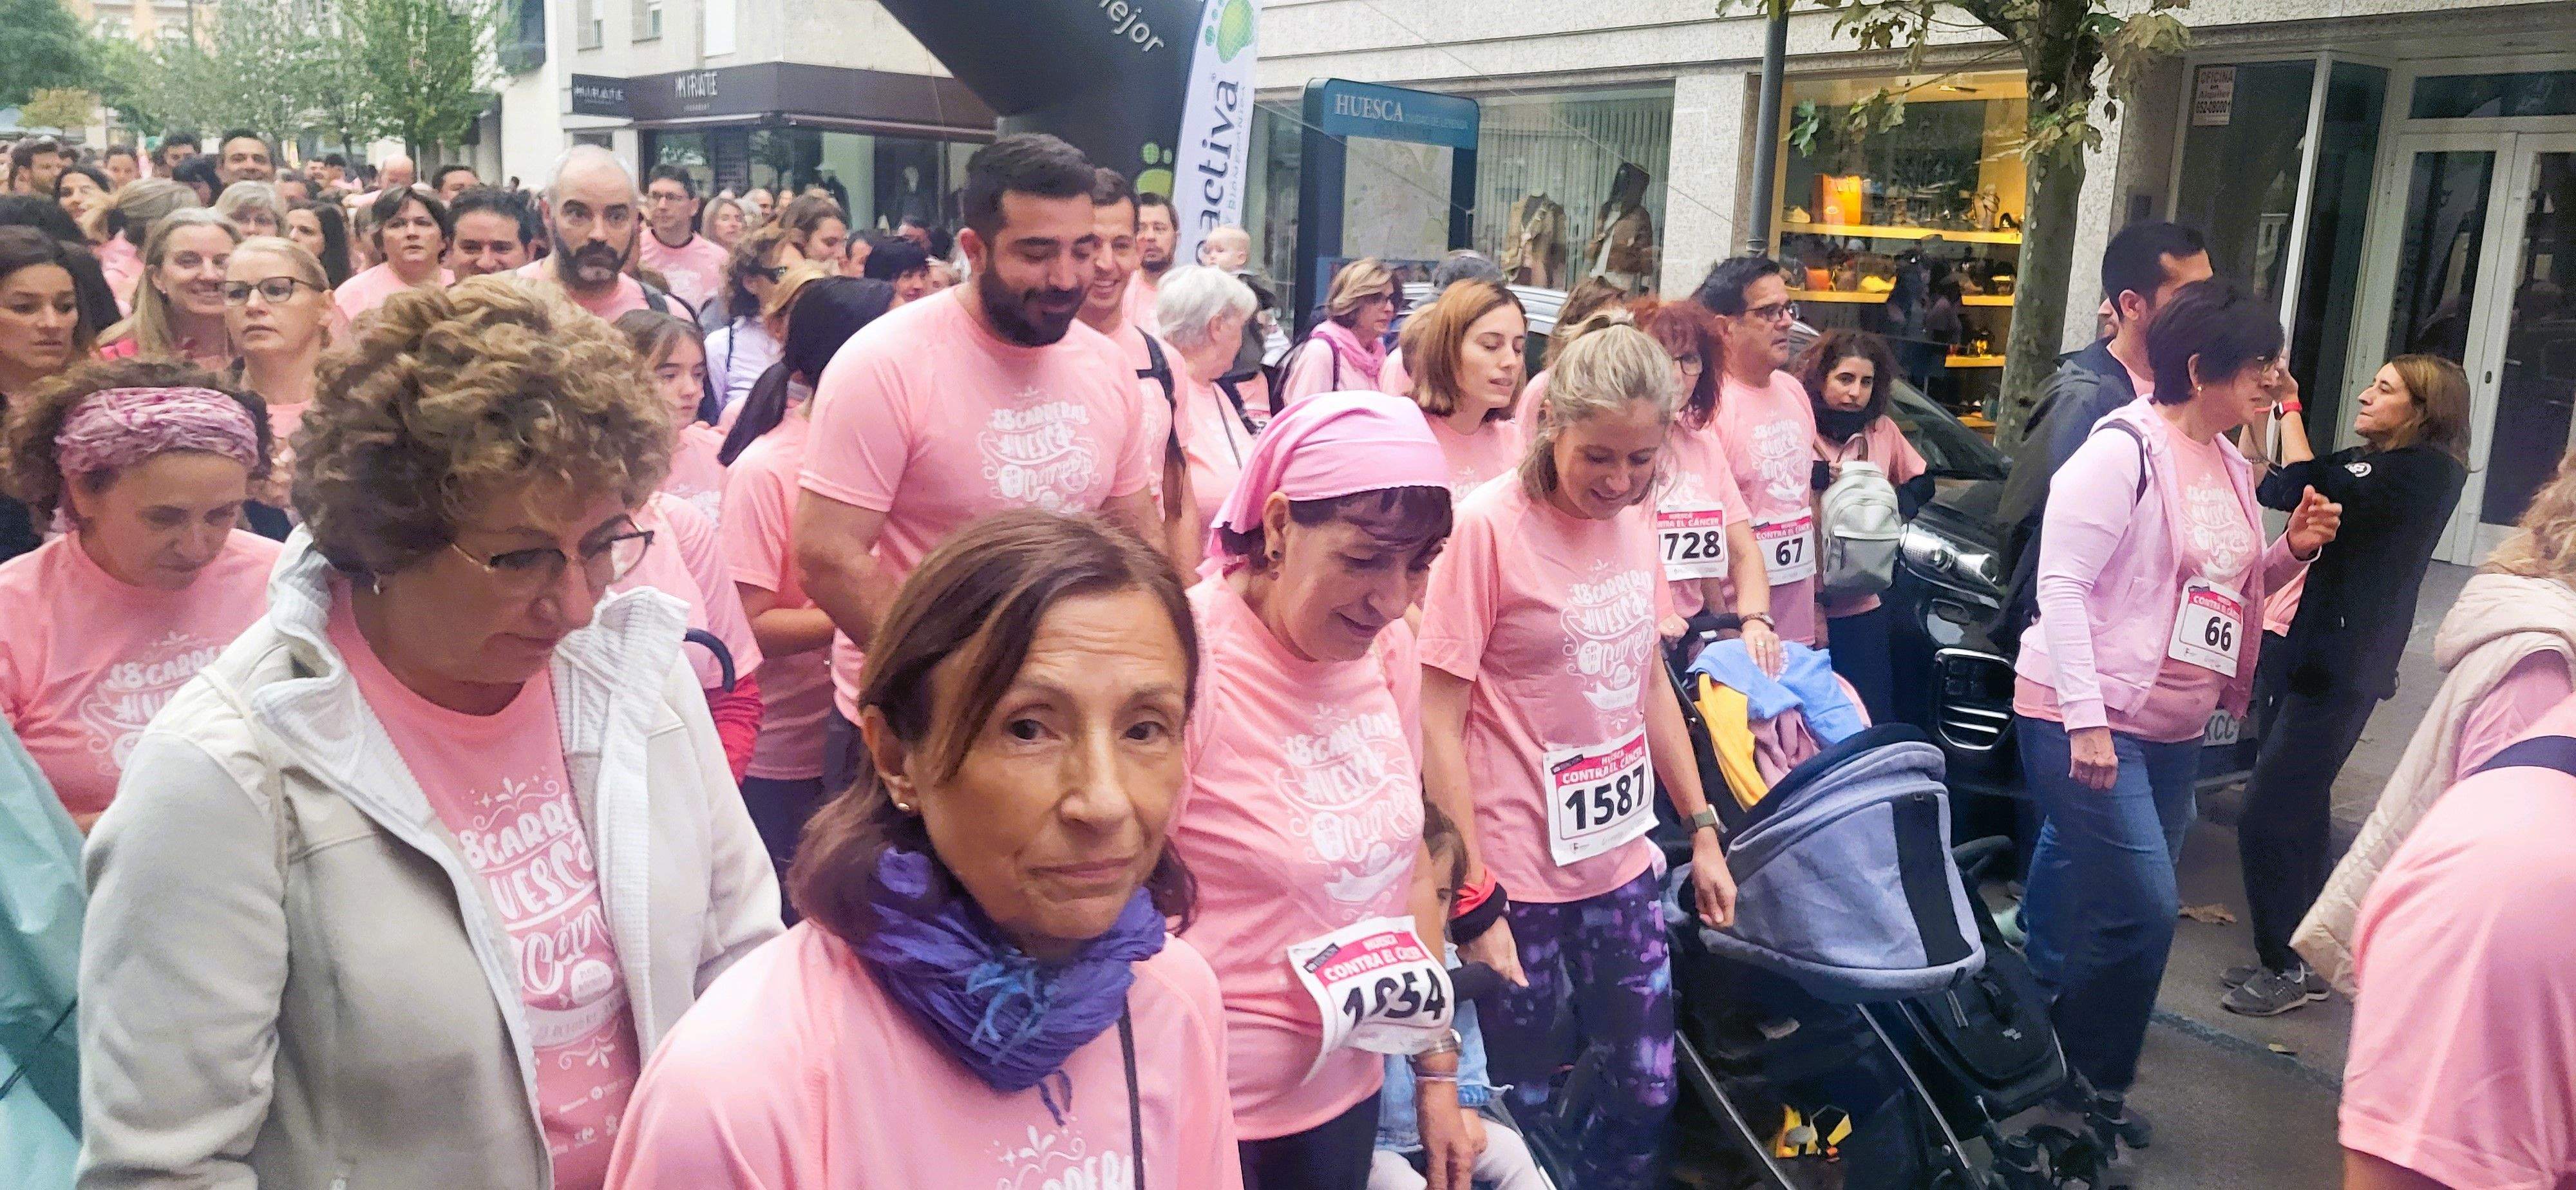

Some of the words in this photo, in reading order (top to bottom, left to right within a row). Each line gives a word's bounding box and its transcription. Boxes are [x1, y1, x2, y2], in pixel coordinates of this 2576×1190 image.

[1335, 94, 1404, 122] HUESCA
[1756, 529, 1787, 540] CONTRA
[1776, 537, 1804, 566] 67
[2205, 616, 2232, 652] 66
[1562, 765, 1610, 784] CONTRA
[1566, 762, 1645, 831] 1587
[1323, 952, 1385, 981] CONTRA
